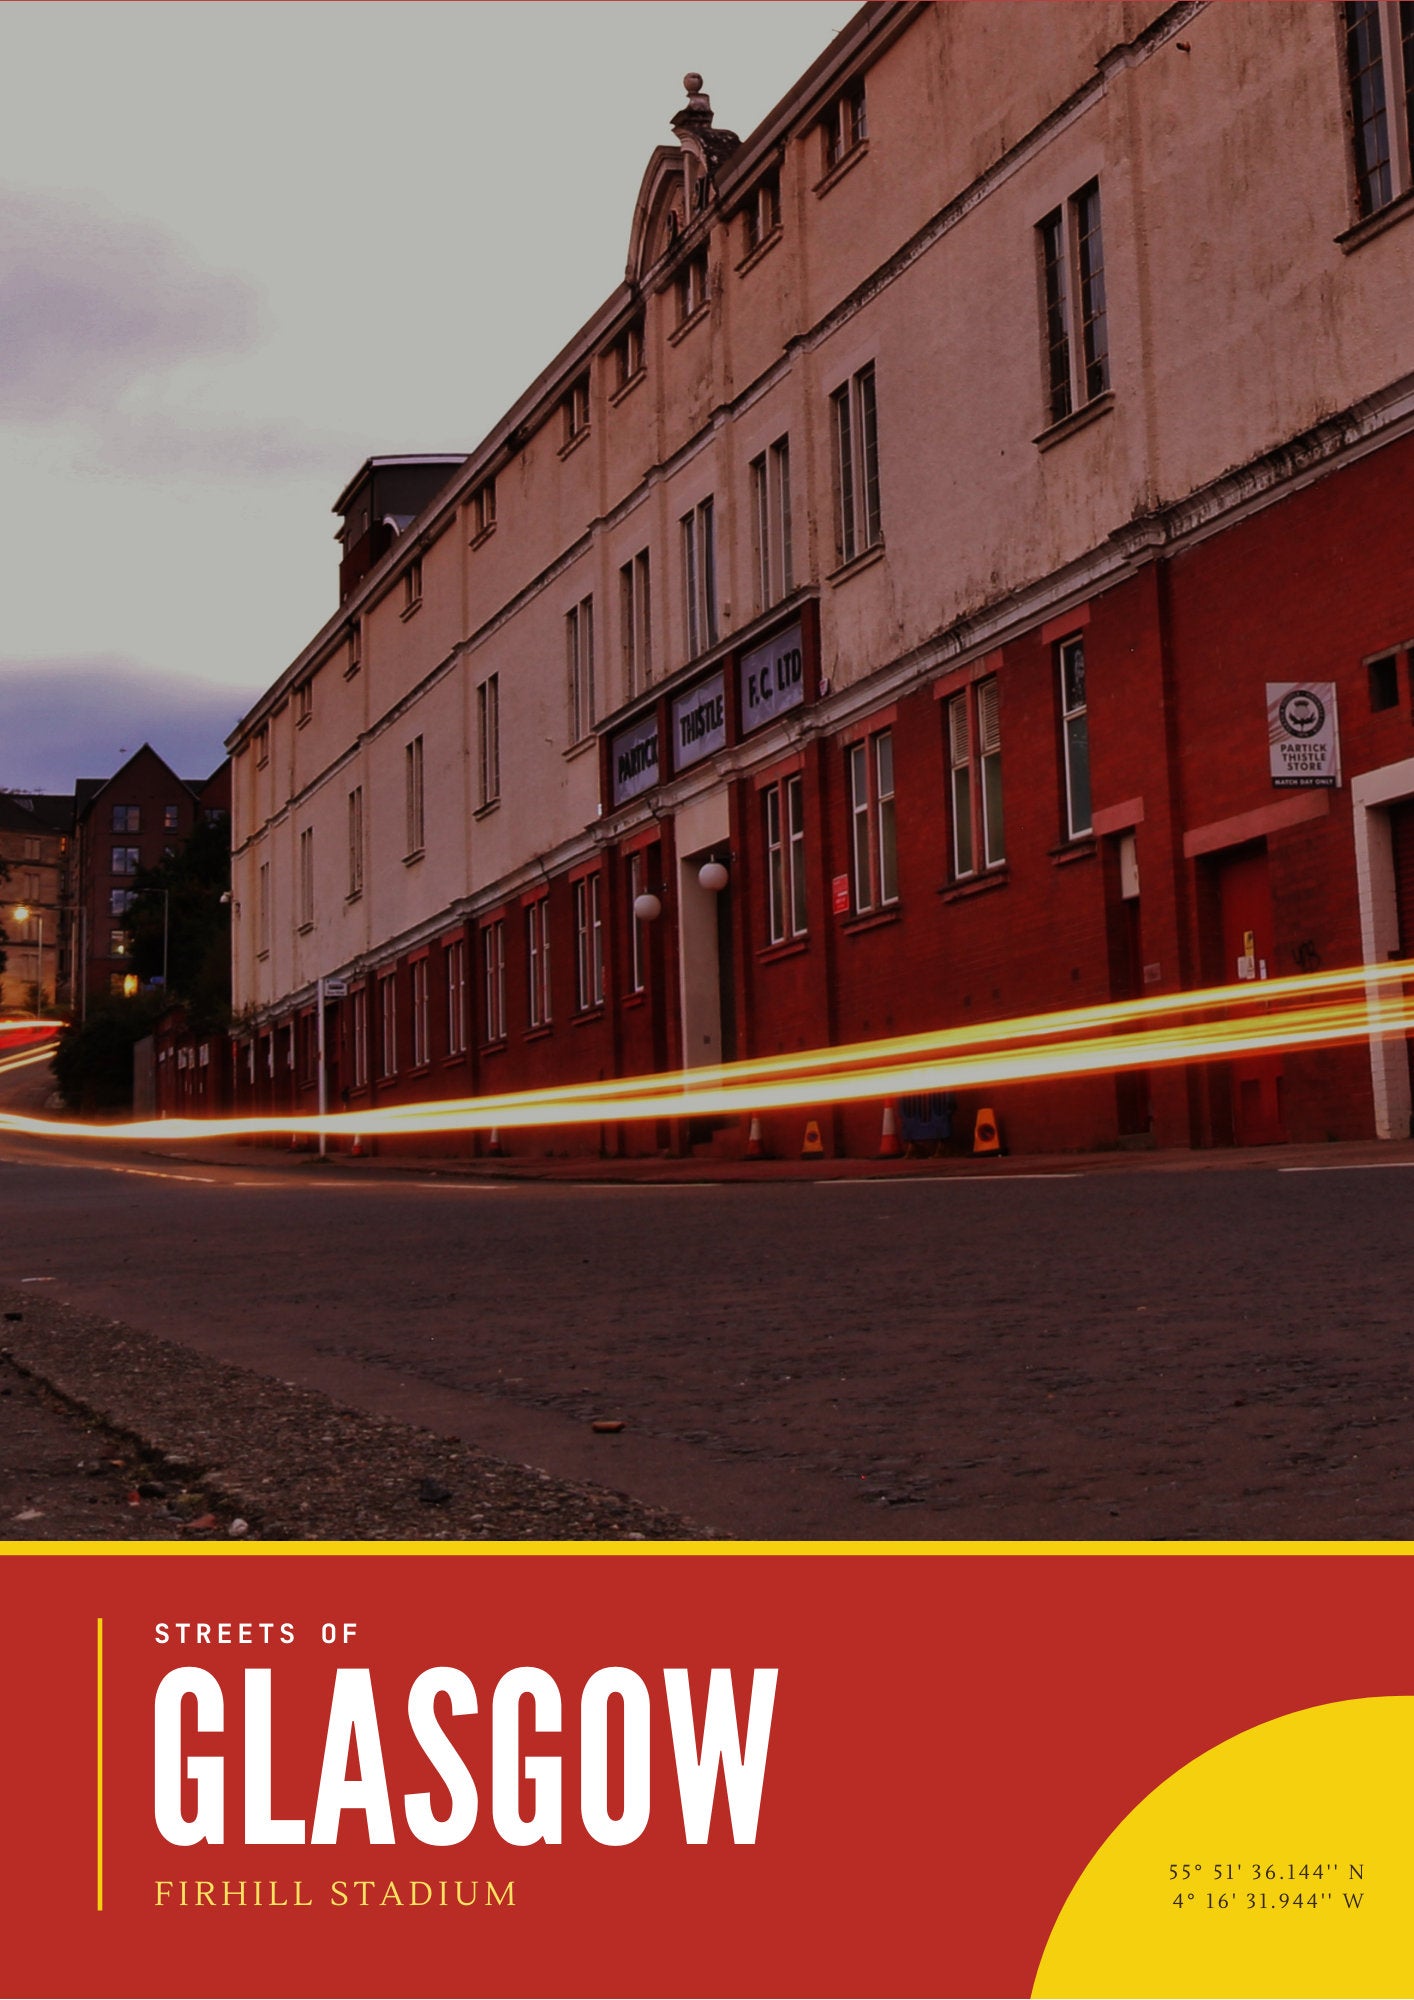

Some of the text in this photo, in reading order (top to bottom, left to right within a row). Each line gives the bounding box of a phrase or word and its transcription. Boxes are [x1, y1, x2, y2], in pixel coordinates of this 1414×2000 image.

[618, 735, 658, 784] PARTICK
[680, 694, 723, 747] THISTLE
[777, 648, 801, 691] LTD
[1280, 744, 1327, 752] PARTICK
[1282, 753, 1326, 761] THISTLE
[1287, 762, 1323, 771] STORE
